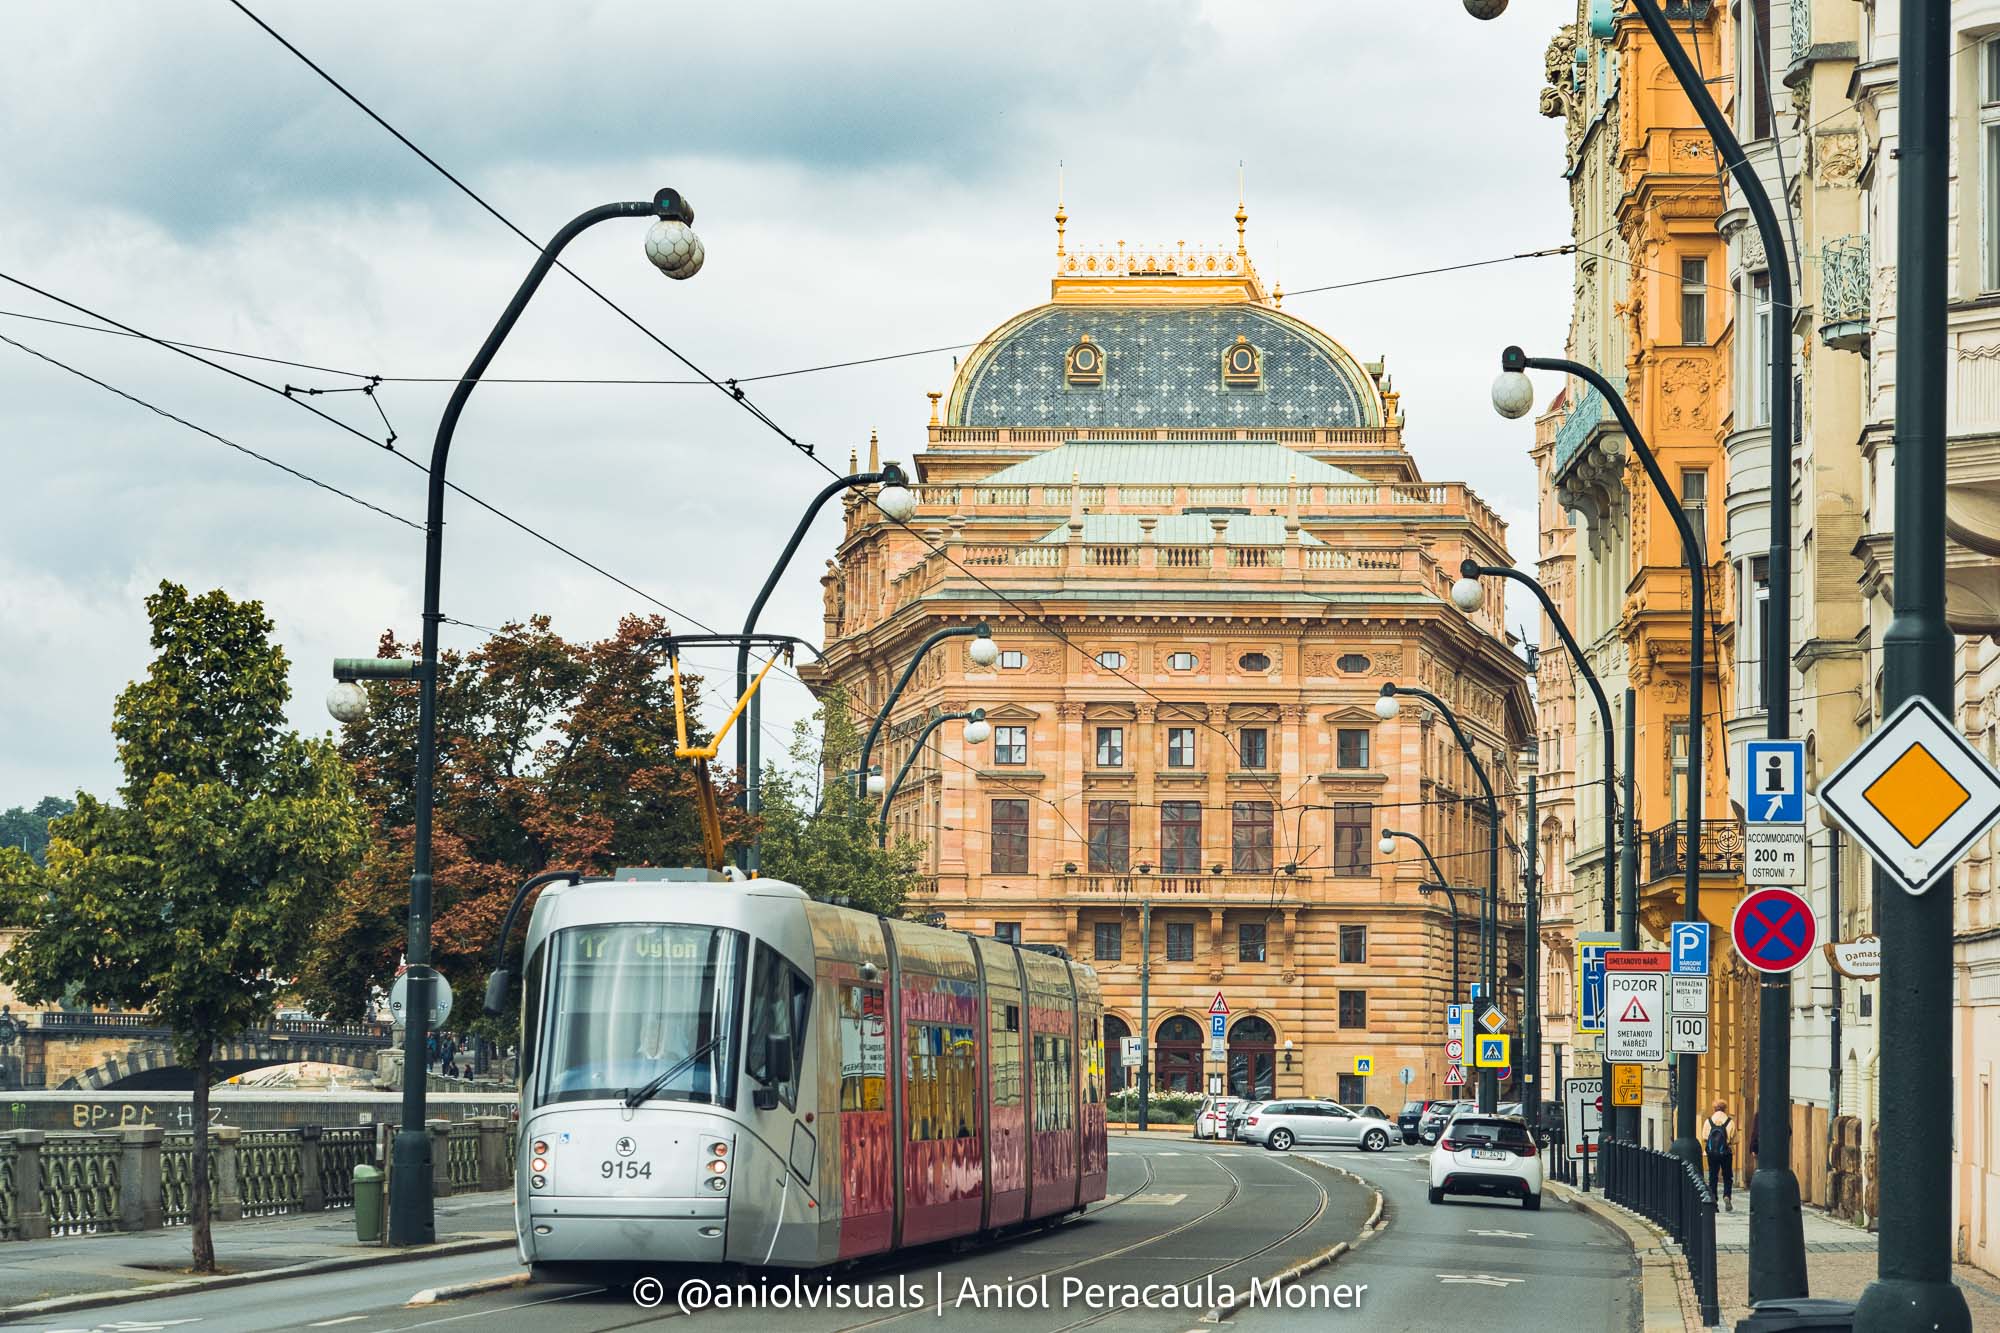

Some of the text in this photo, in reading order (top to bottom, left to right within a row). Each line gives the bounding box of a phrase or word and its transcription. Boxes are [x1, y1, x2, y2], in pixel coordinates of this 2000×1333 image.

[1747, 833, 1804, 843] ACCOMMODATION
[1754, 849, 1795, 862] 200 m
[1789, 868, 1796, 878] 7
[580, 934, 608, 958] 17
[1679, 932, 1700, 960] P
[1612, 979, 1657, 991] POZOR
[1676, 987, 1691, 995] MÍSTA
[1675, 1019, 1702, 1036] 100
[1617, 1030, 1653, 1038] SMETANOVO
[1622, 1039, 1648, 1048] NÁBŘEŽÍ
[1610, 1049, 1660, 1057] PROVOZ OMEZEN
[1570, 1082, 1603, 1094] POZO
[601, 1160, 652, 1180] 9154
